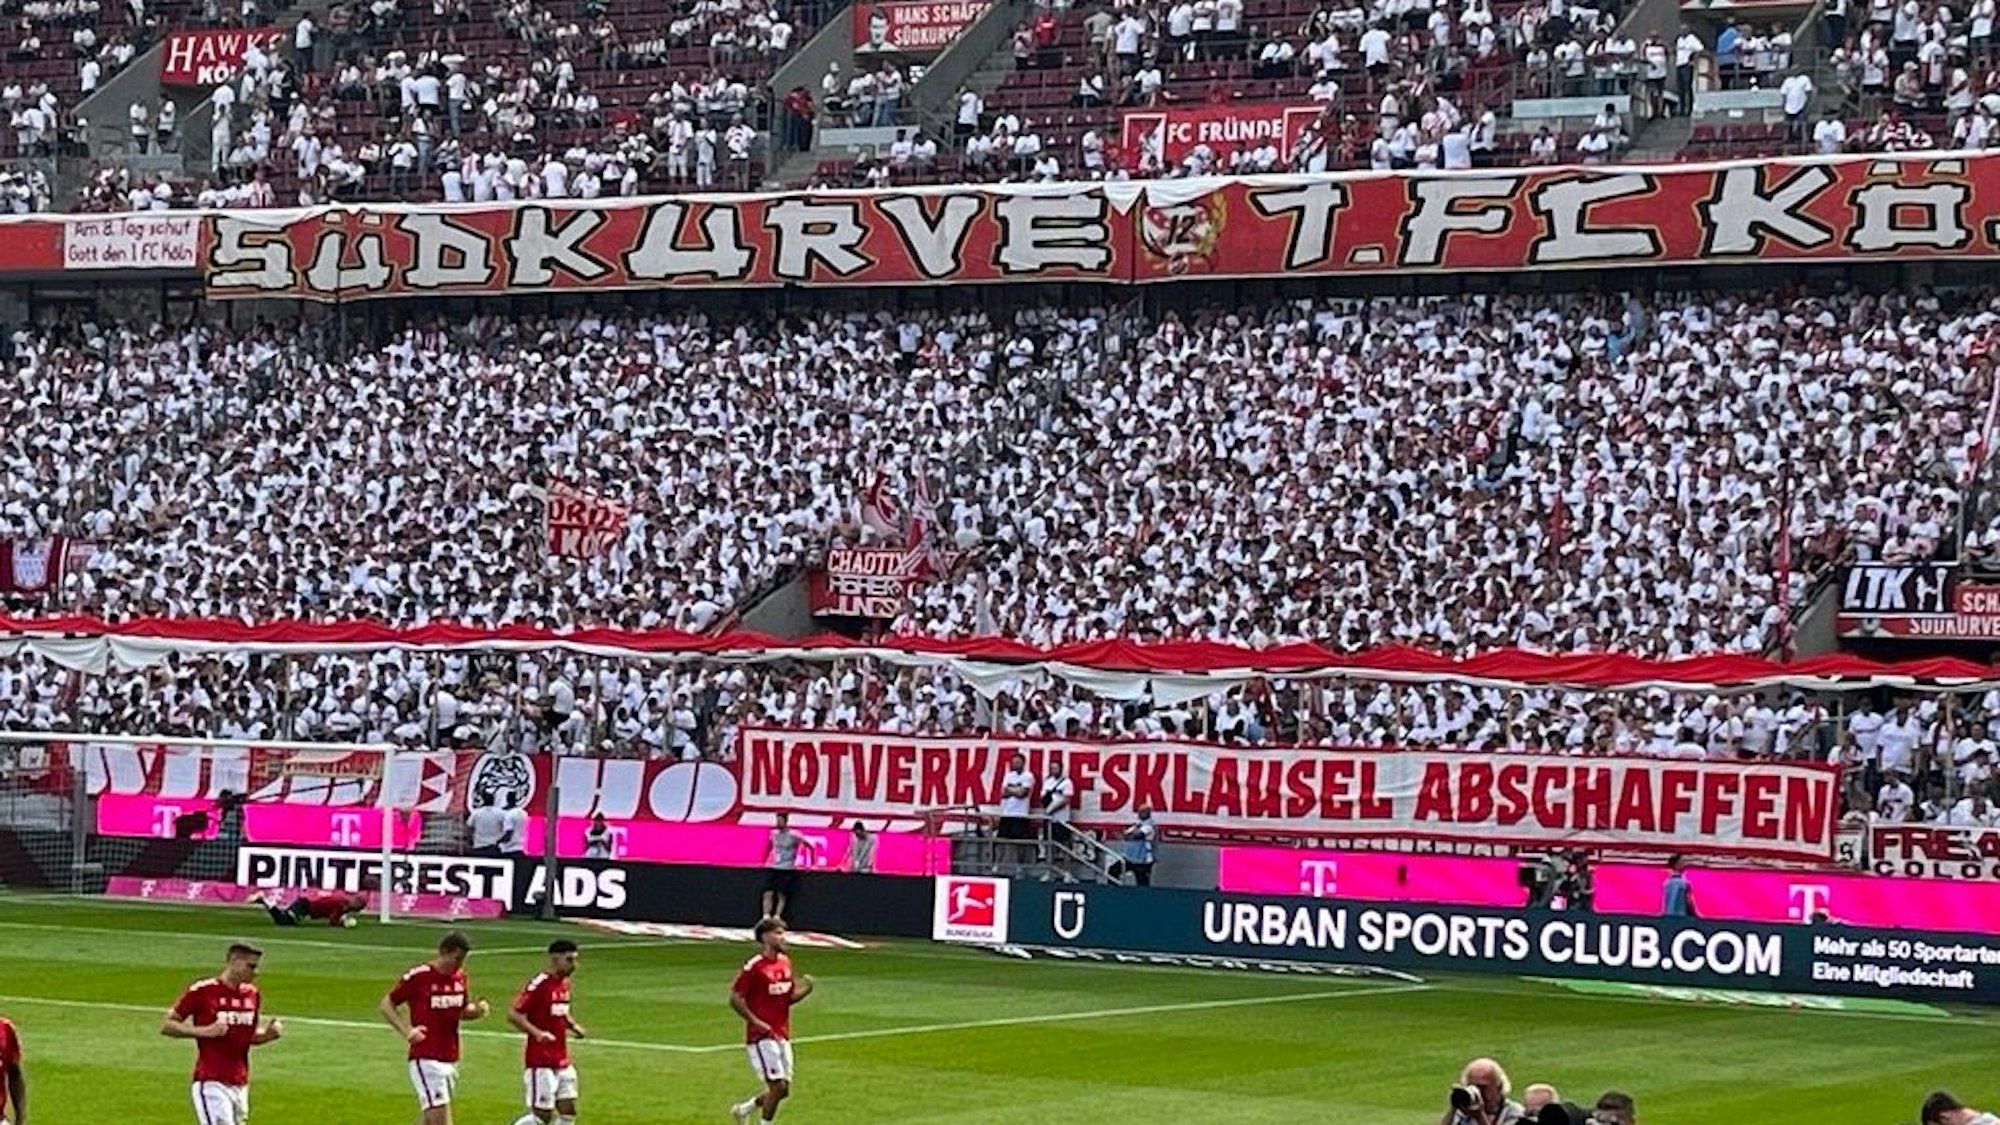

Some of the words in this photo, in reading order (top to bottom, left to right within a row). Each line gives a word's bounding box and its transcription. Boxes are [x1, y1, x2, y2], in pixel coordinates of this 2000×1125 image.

[894, 6, 929, 24] HANS
[1167, 122, 1192, 143] FC
[1199, 117, 1282, 142] FRÜNDE
[1702, 158, 2000, 255] KÖ
[75, 219, 98, 236] Am
[121, 217, 144, 240] Tag
[148, 218, 190, 235] schuf
[68, 244, 97, 262] Gott
[102, 244, 127, 261] den
[141, 243, 158, 260] FC
[161, 242, 193, 260] Köln
[207, 193, 1109, 291] SÜDKURVE
[1843, 567, 1914, 609] LTK
[1962, 592, 2000, 613] SCH
[1413, 760, 1837, 845] ABSCHAFFEN
[248, 853, 504, 902] PINTEREST
[525, 866, 627, 909] ADS
[1874, 860, 2000, 880] COLO
[1203, 901, 1346, 949] URBAN
[1357, 910, 1529, 960] SPORTS
[1539, 920, 1781, 976] CLUB.COM
[1813, 935, 1859, 956] Mehr
[1860, 939, 1886, 957] als
[1887, 940, 1911, 959] 50
[1812, 961, 1850, 981] Eine
[1852, 963, 1975, 988] Mitgliedschaft
